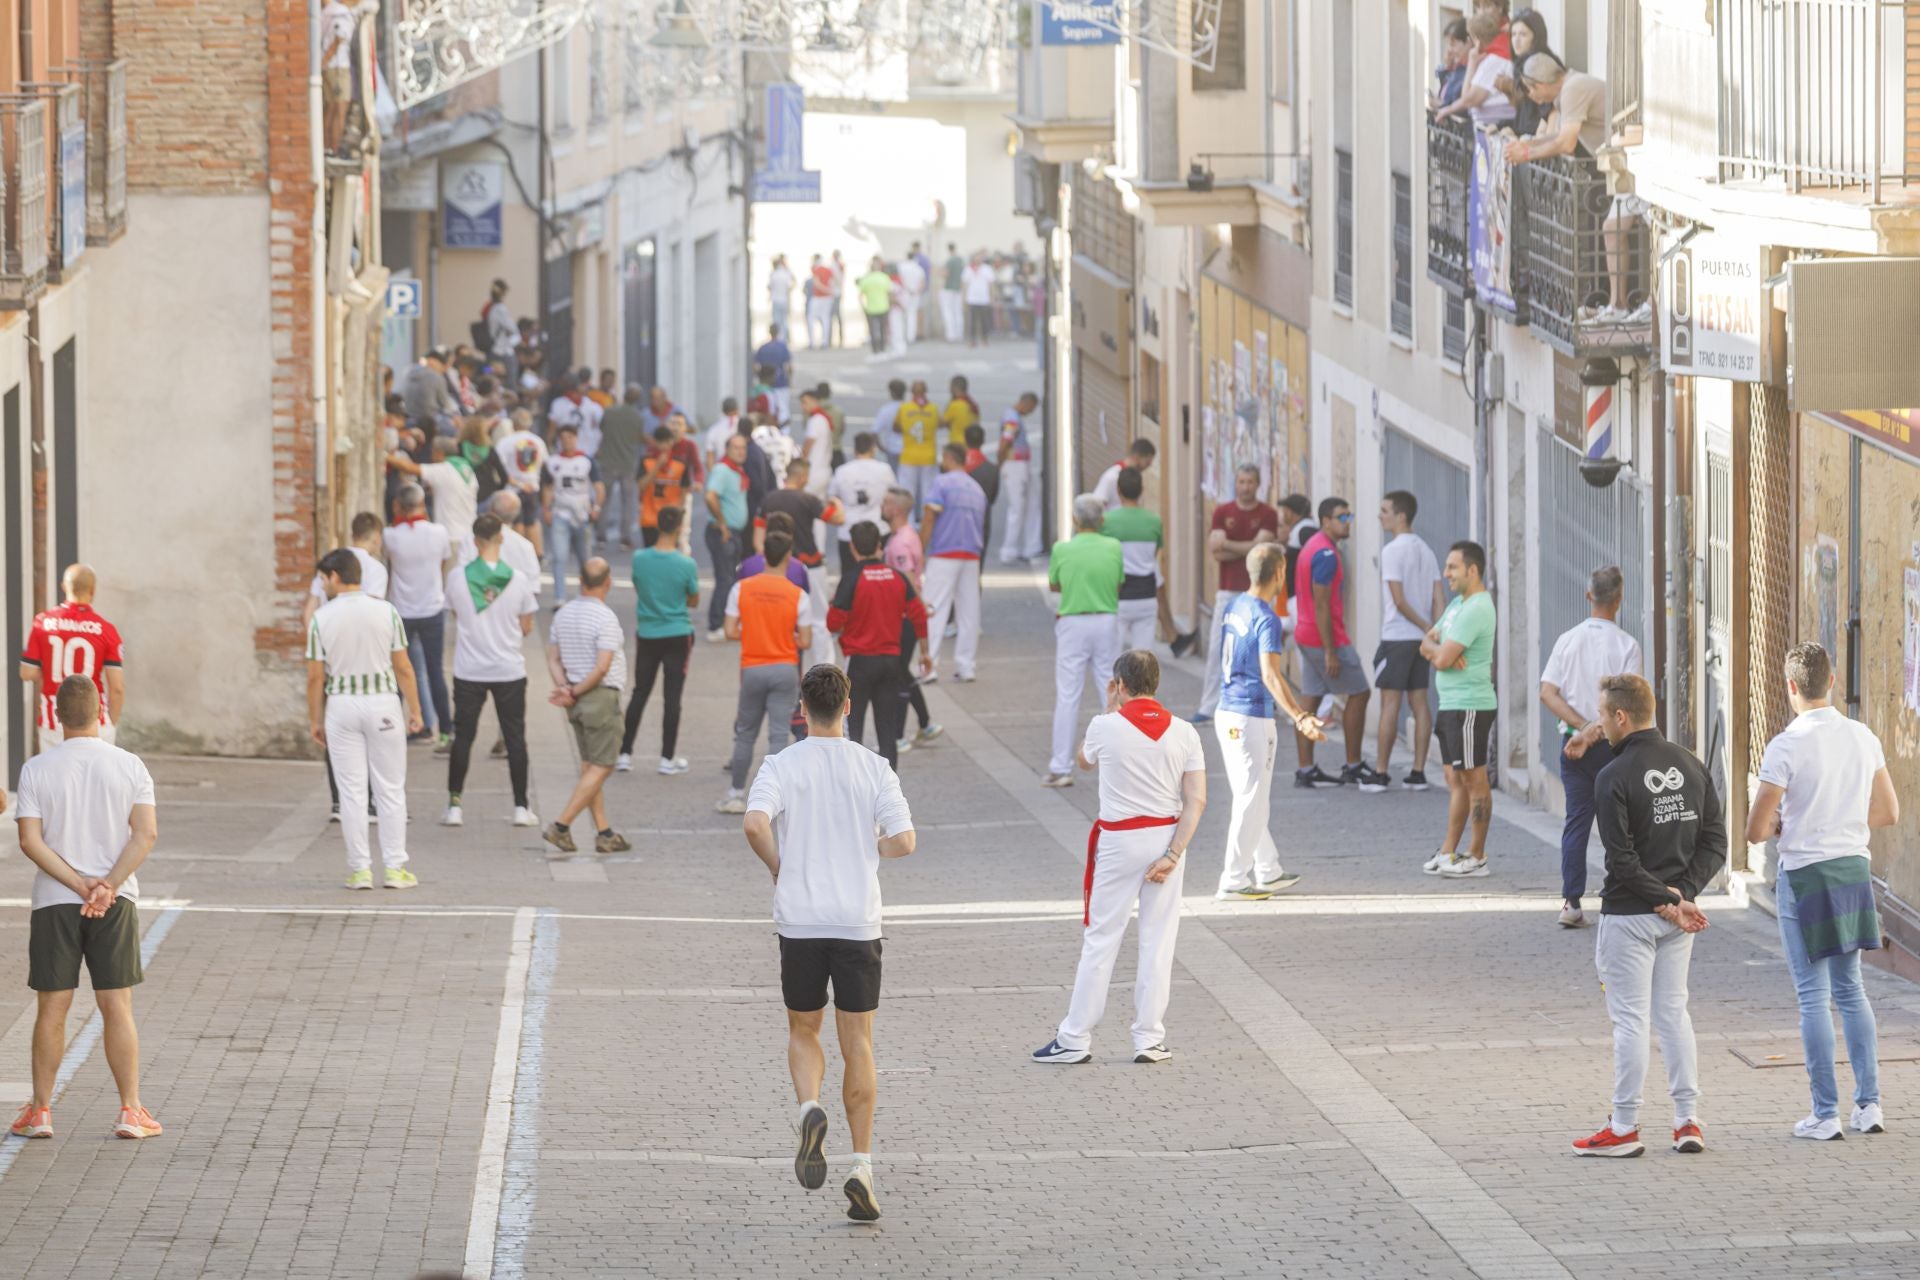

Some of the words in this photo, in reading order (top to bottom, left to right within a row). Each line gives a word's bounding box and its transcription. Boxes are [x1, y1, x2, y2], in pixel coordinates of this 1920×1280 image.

[1062, 26, 1103, 40] Seguros
[1701, 260, 1752, 279] PUERTAS
[391, 284, 414, 314] P
[1698, 294, 1754, 334] TEYSAN
[1718, 353, 1728, 369] 921
[1730, 354, 1737, 369] 14
[1738, 355, 1746, 370] 25
[1746, 356, 1754, 371] 37
[910, 421, 924, 444] 4
[48, 635, 96, 683] 10
[1653, 794, 1684, 806] CARAMA
